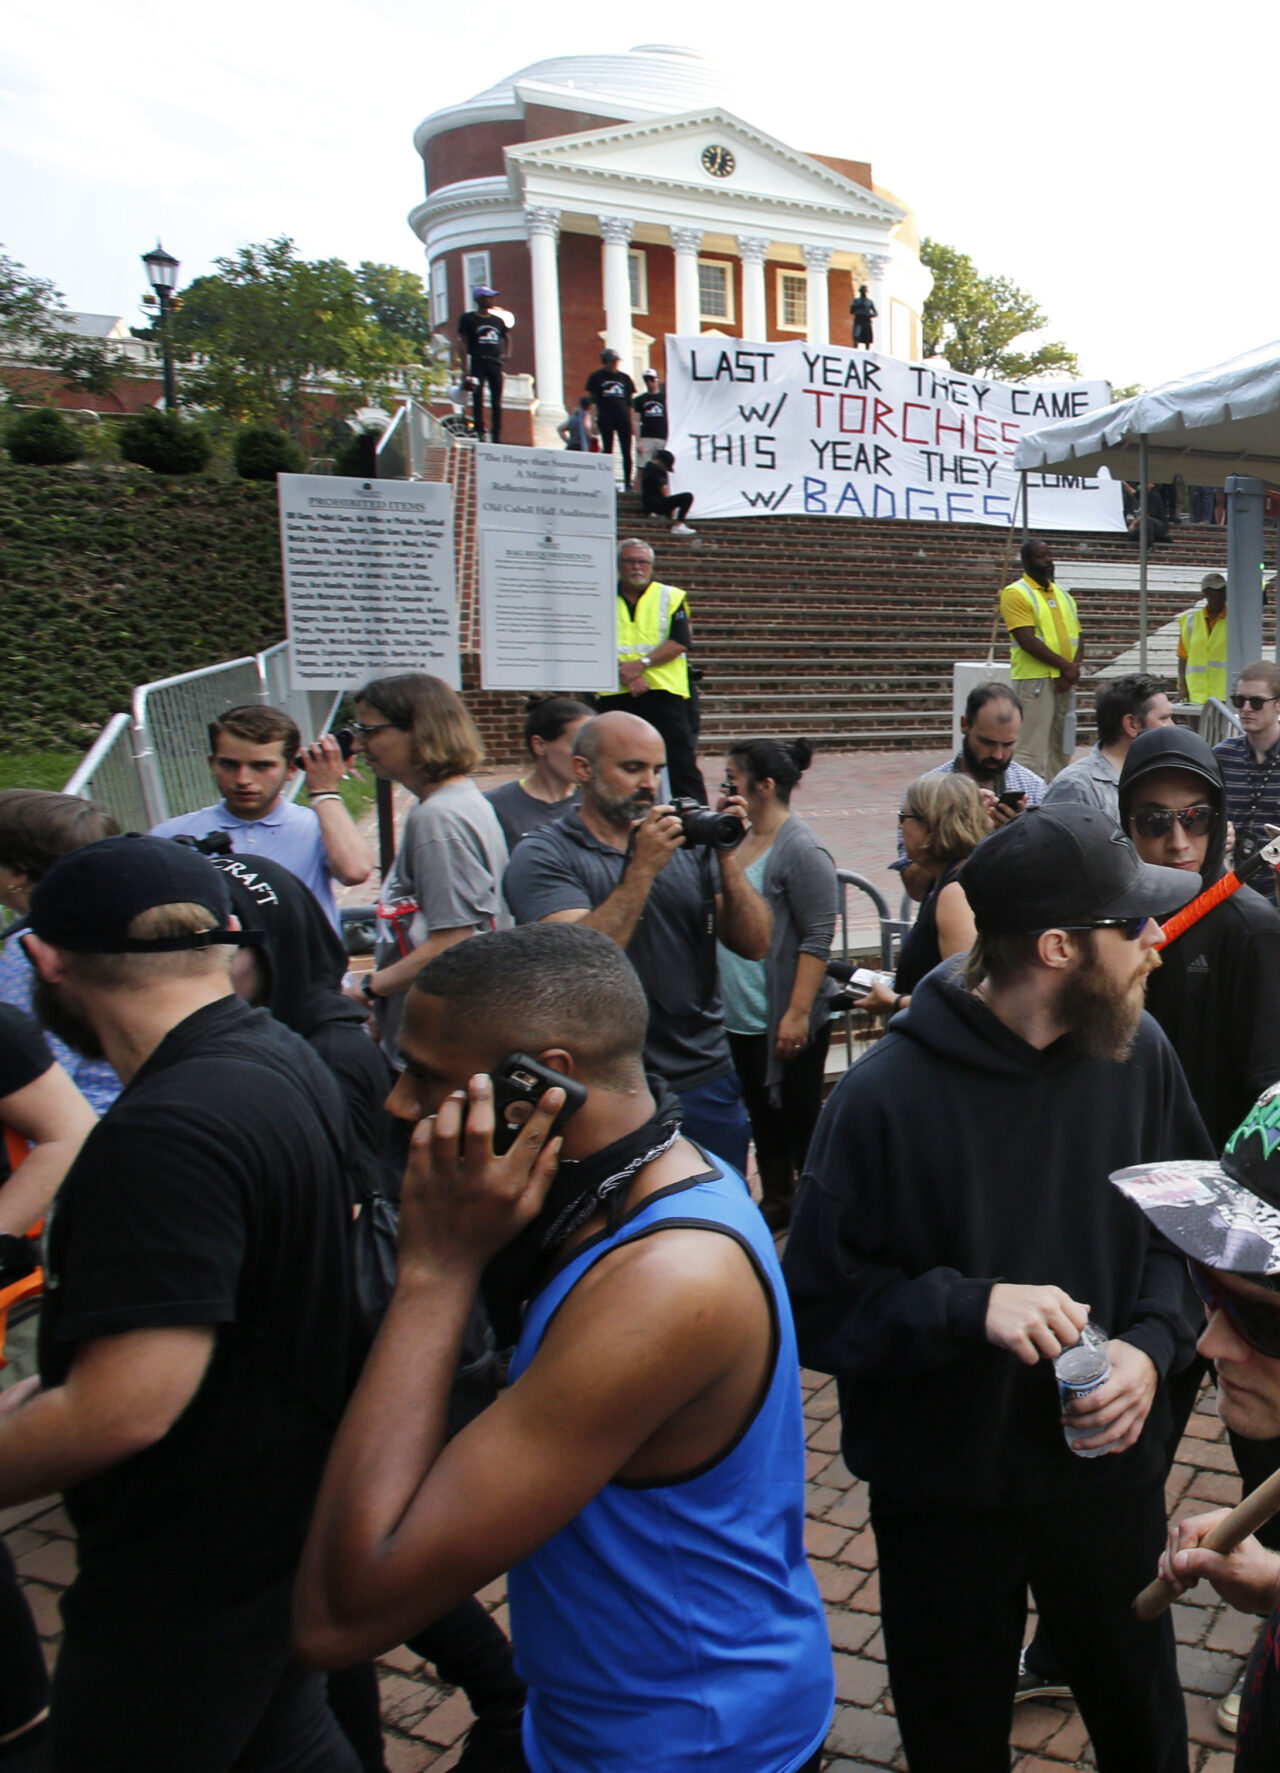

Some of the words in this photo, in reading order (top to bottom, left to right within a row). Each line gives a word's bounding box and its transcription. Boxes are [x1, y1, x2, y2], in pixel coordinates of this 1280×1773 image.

[689, 349, 775, 383] LAST
[802, 351, 882, 392] YEAR
[909, 366, 991, 412] THEY
[1011, 390, 1089, 418] CAME
[802, 389, 1020, 457] TORCHES
[689, 434, 776, 469] THIS
[810, 438, 893, 476] YEAR
[919, 450, 998, 488] THEY
[308, 496, 386, 510] PROHIBITED
[388, 500, 426, 512] ITEMS
[803, 476, 1013, 523] BADGES
